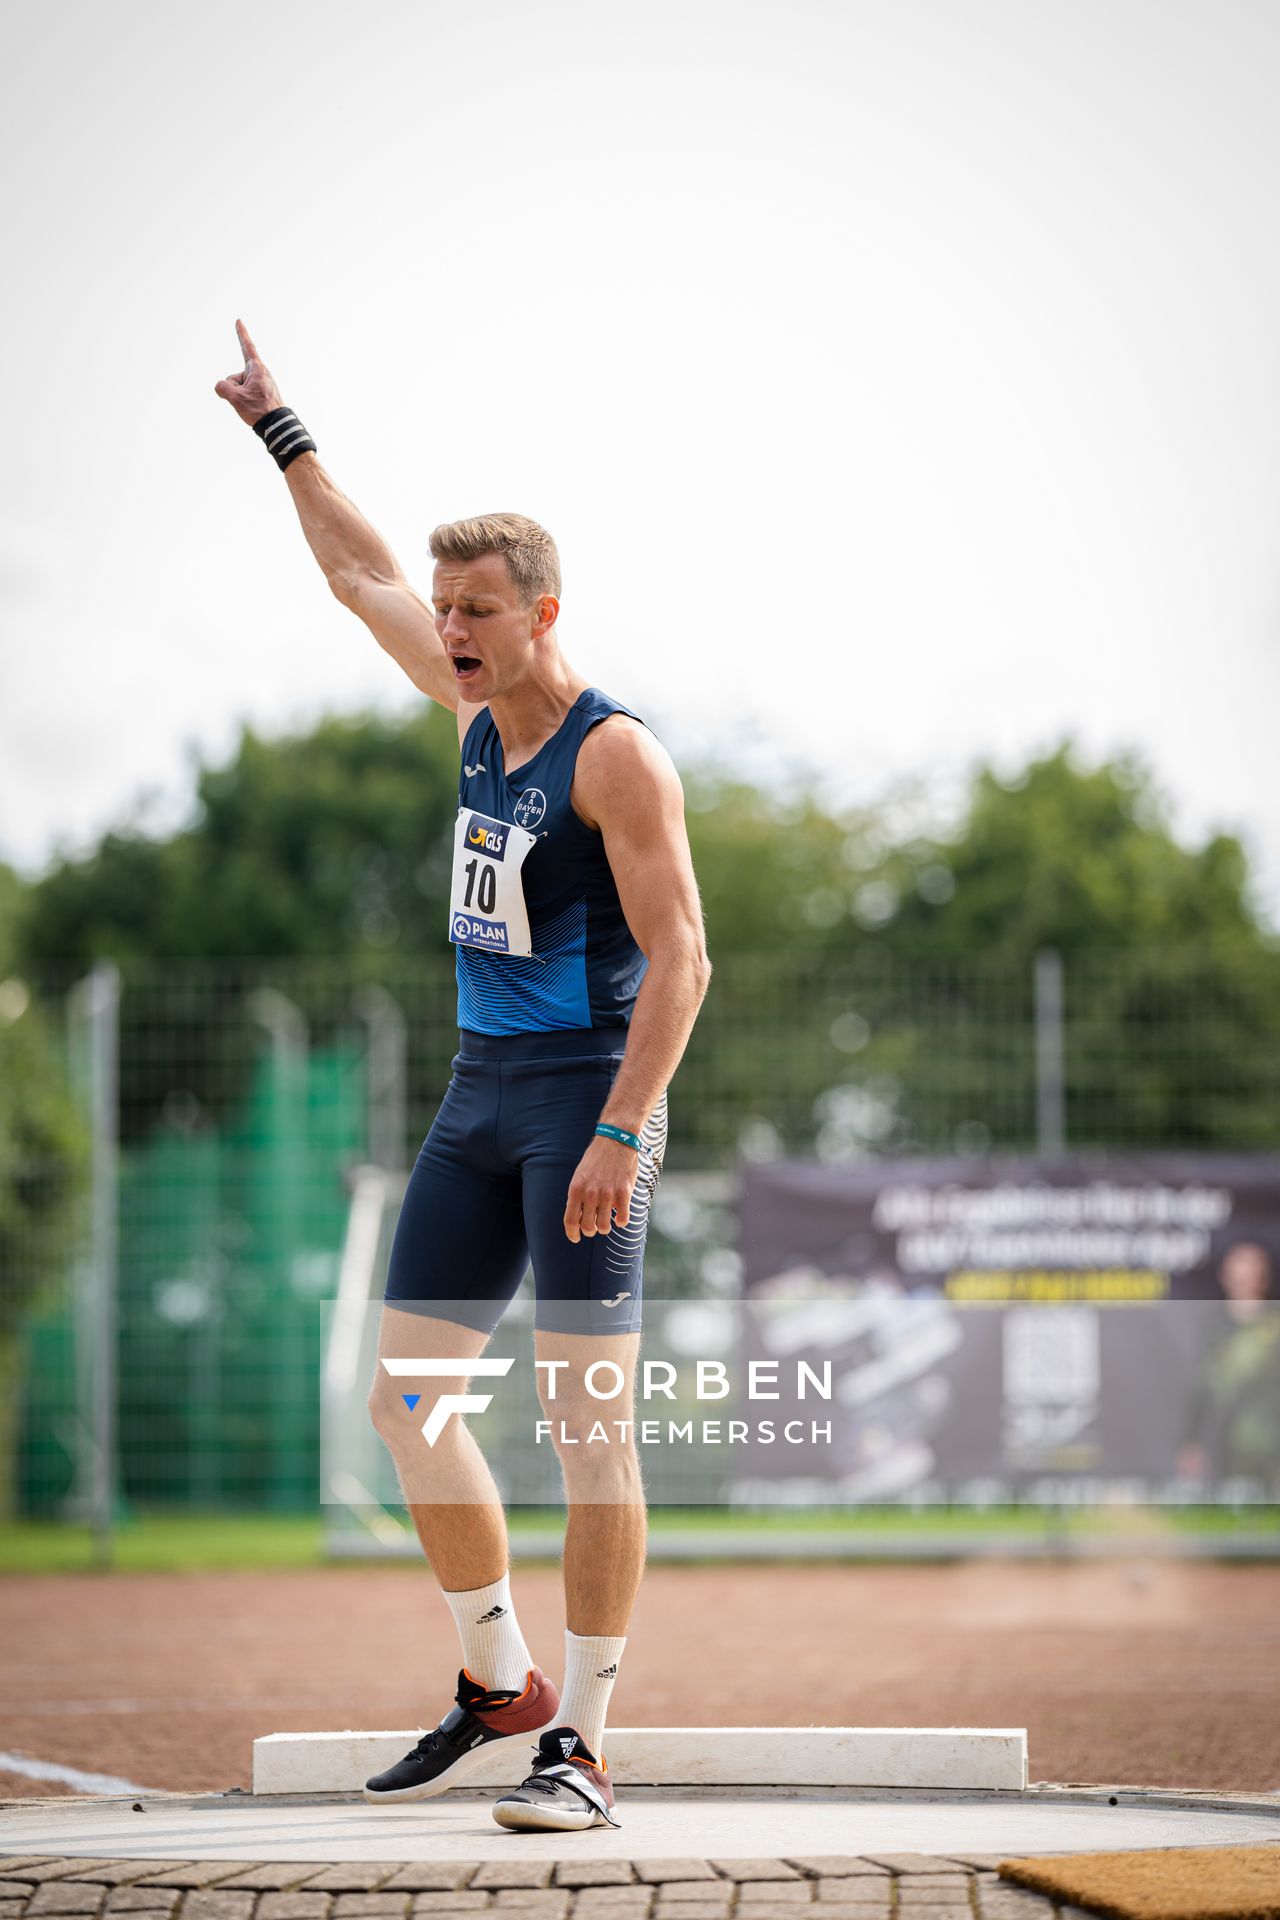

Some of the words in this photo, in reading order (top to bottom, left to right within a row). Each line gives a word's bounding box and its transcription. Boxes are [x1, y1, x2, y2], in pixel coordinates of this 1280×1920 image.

[517, 803, 543, 815] BAYER
[486, 832, 503, 852] GLS
[464, 859, 496, 914] 10
[472, 922, 505, 941] PLAN
[472, 937, 506, 948] INTERNATIONAL
[564, 1735, 579, 1759] adidas
